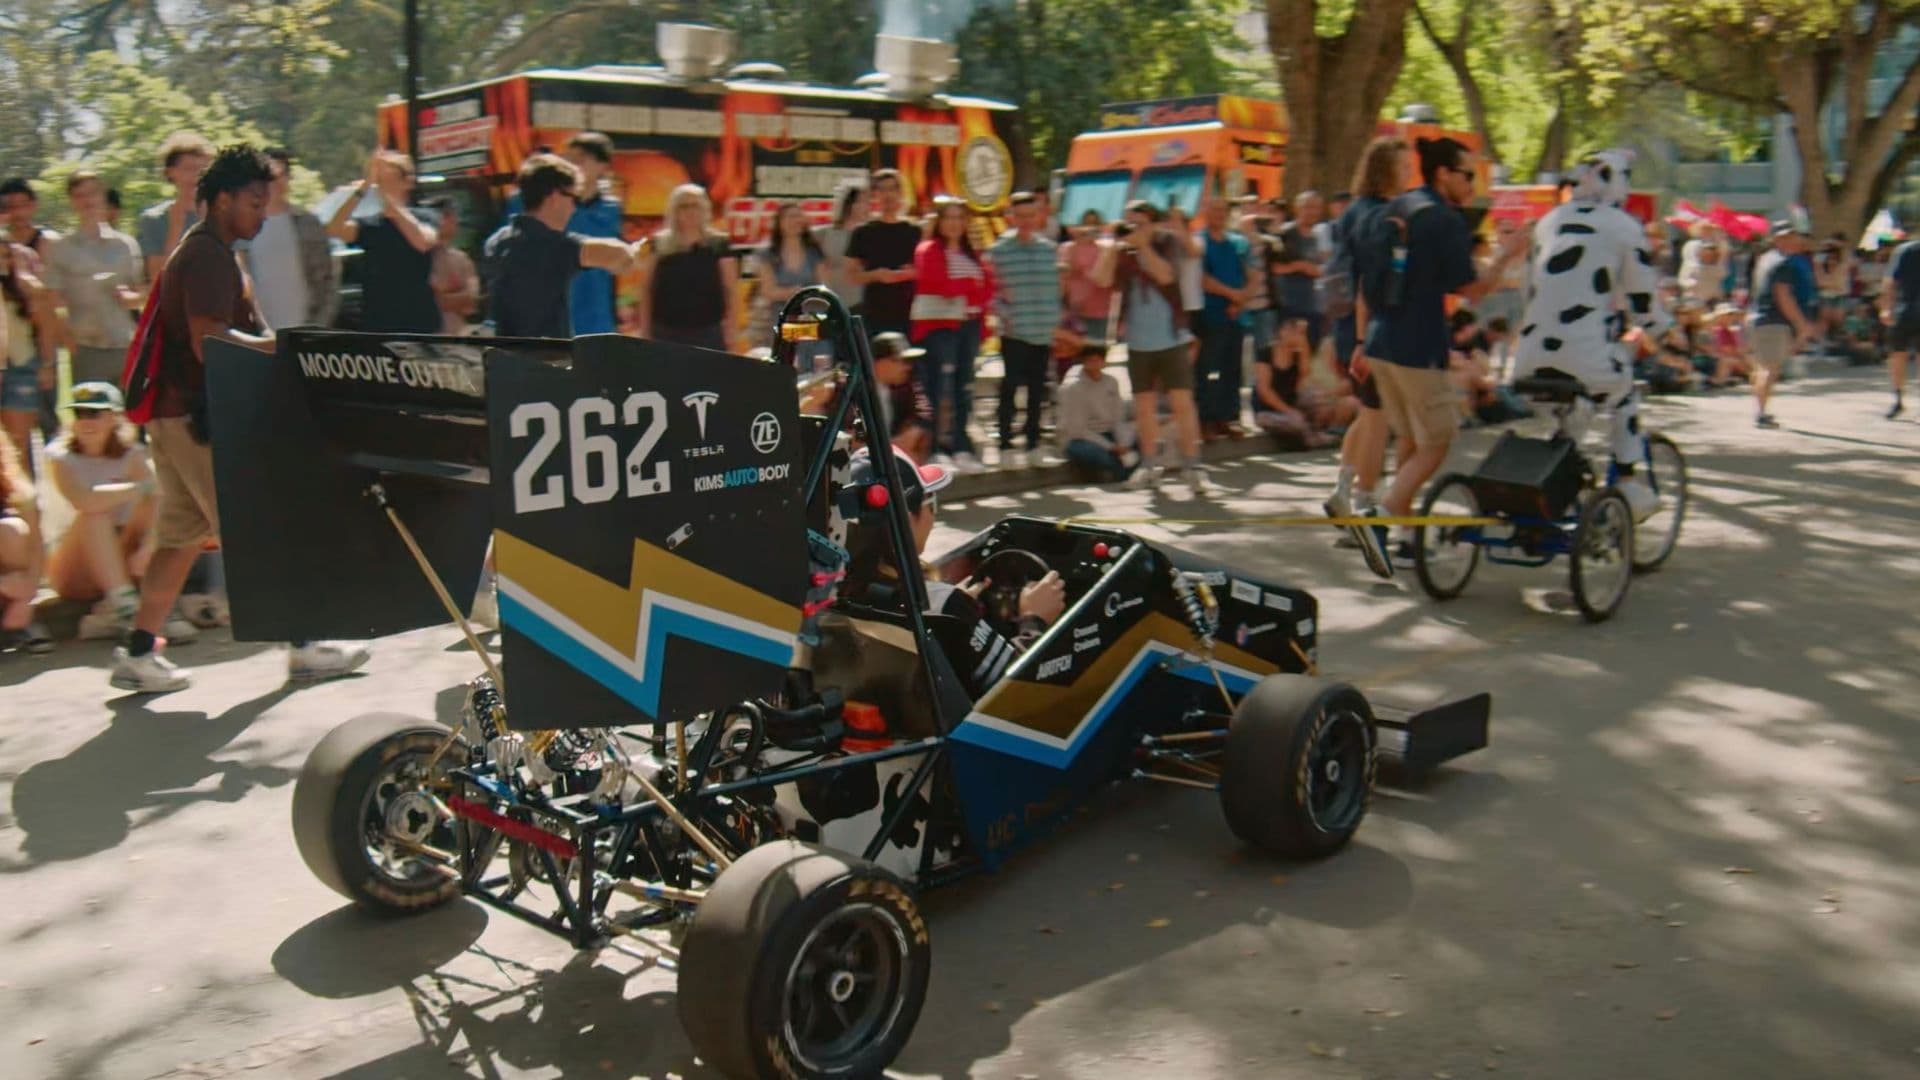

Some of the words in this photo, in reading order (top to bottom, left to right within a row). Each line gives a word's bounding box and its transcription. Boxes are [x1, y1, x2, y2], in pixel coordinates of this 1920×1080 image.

[298, 352, 399, 384] MOOOOVE
[753, 417, 779, 447] ZF
[509, 391, 671, 514] 262
[683, 444, 725, 459] TESLA
